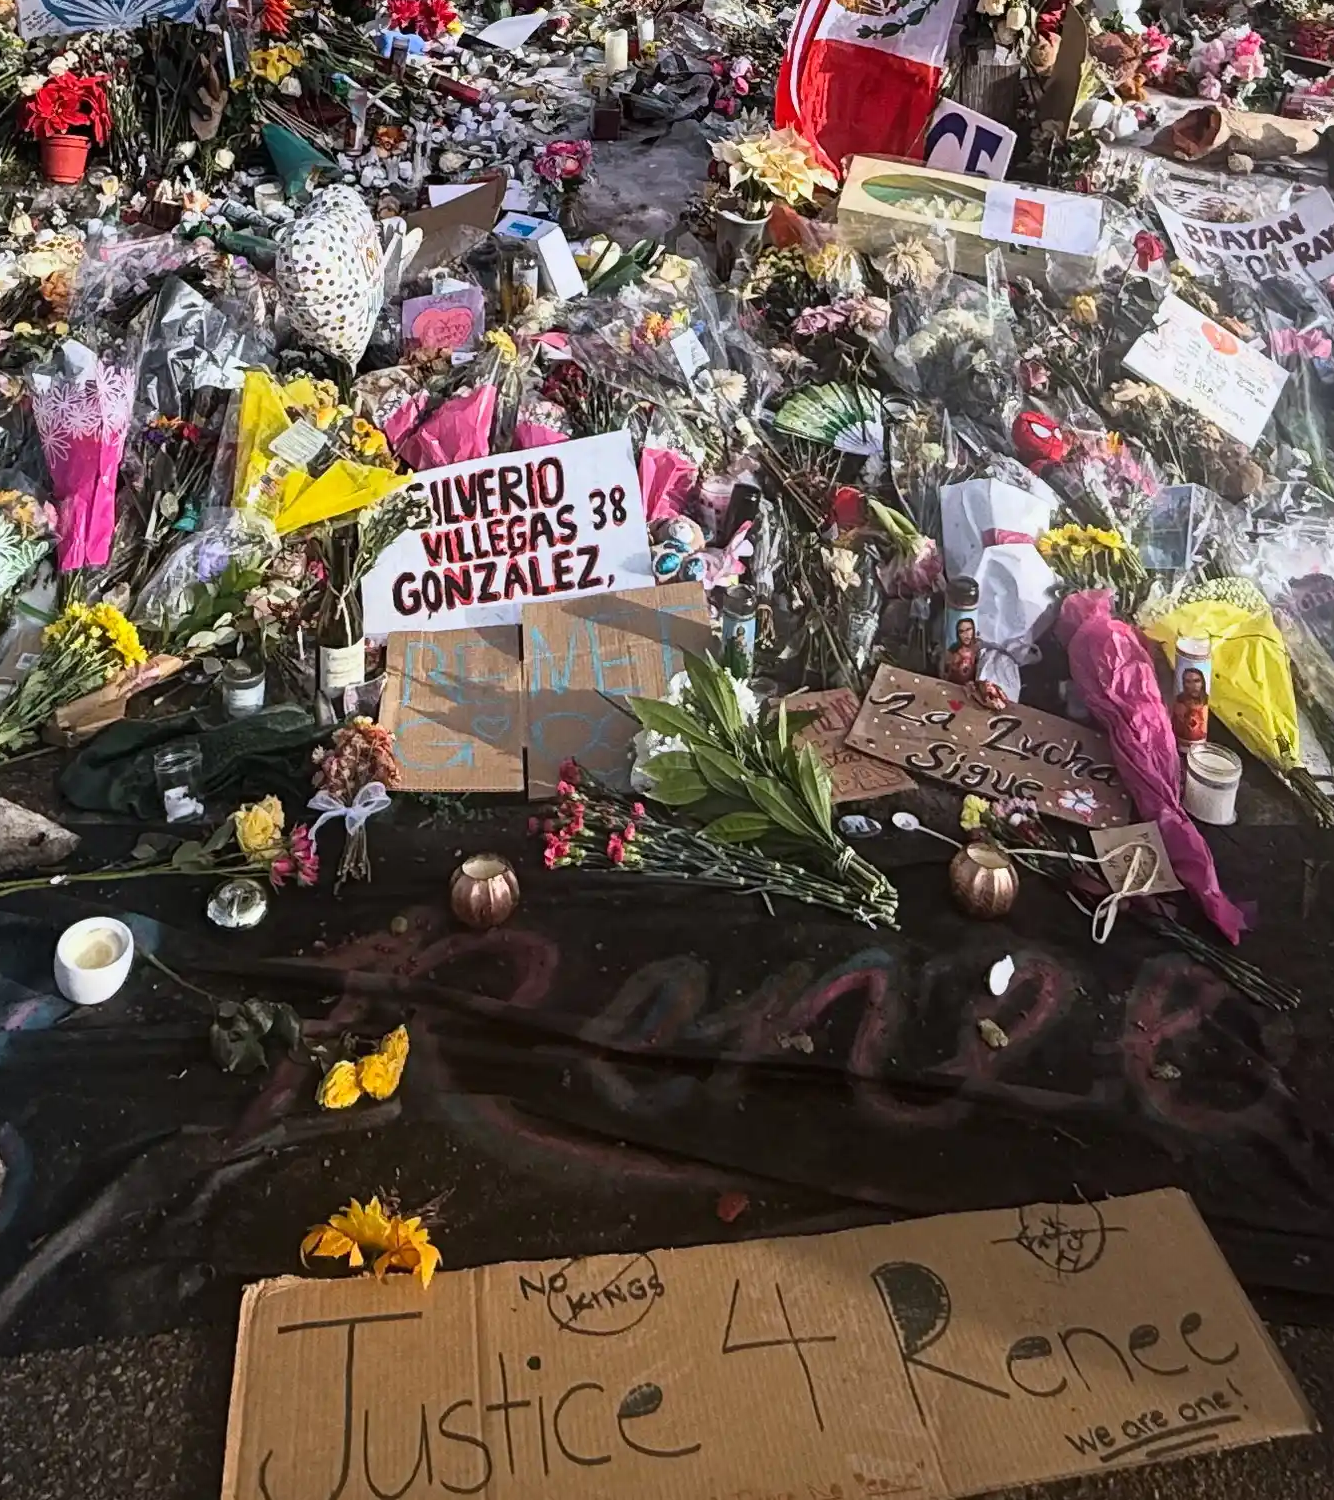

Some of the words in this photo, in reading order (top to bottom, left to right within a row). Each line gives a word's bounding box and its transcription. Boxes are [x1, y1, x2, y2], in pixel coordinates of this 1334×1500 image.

[1181, 212, 1305, 251] BRAYAN
[420, 503, 579, 567] VILLEGAS
[588, 485, 628, 531] 38
[904, 740, 1044, 801] Sigue
[518, 1264, 568, 1301] NO
[565, 1272, 665, 1318] KINGS
[259, 1311, 702, 1500] Justice
[722, 1278, 837, 1432] 4
[871, 1259, 1240, 1428] Renee
[1120, 1409, 1166, 1442] are
[1177, 1377, 1250, 1425] one!
